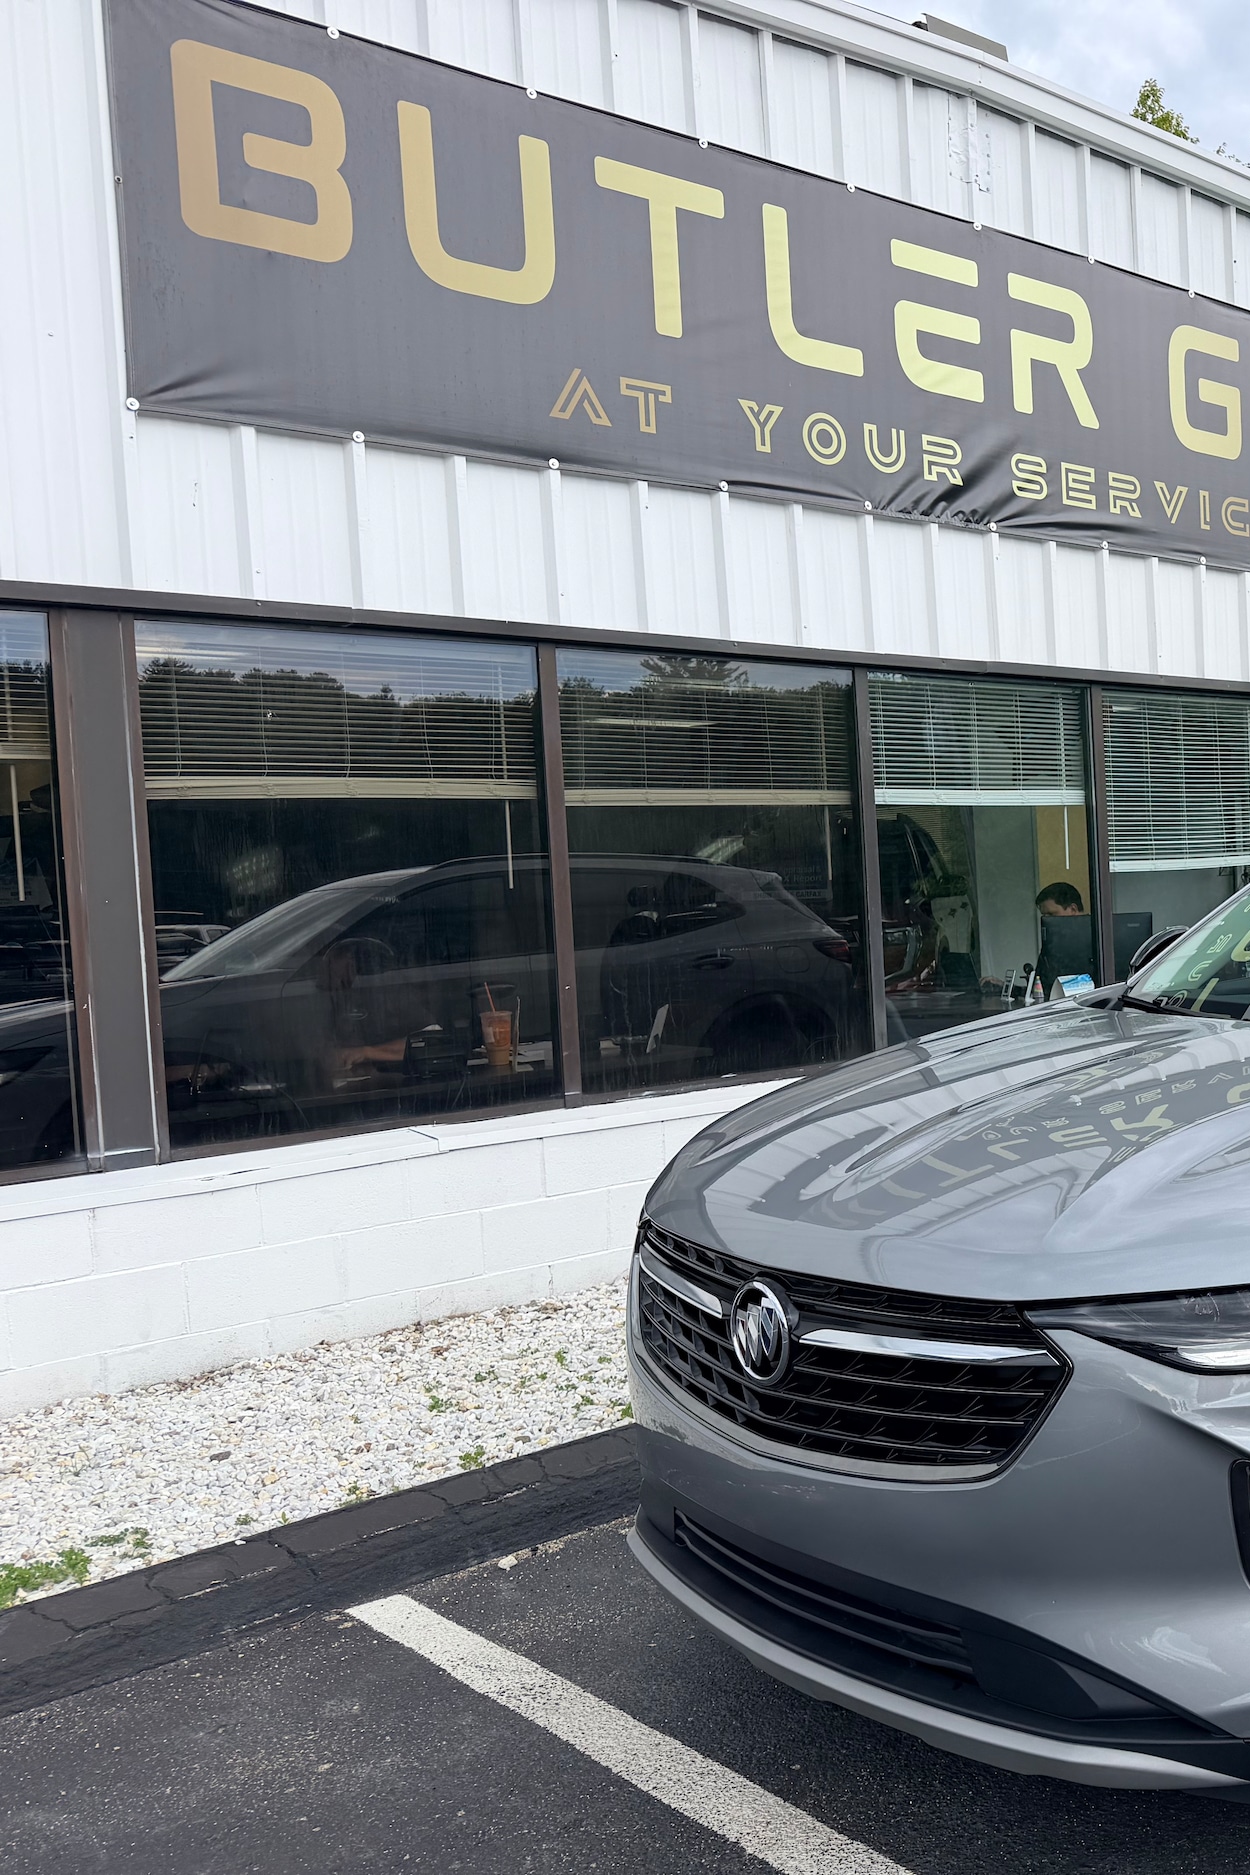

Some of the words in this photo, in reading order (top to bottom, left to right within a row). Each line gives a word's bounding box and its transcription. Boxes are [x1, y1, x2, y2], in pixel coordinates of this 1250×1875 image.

[169, 38, 1100, 430] BUTLER
[548, 367, 672, 435] AT
[737, 397, 964, 486] YOUR
